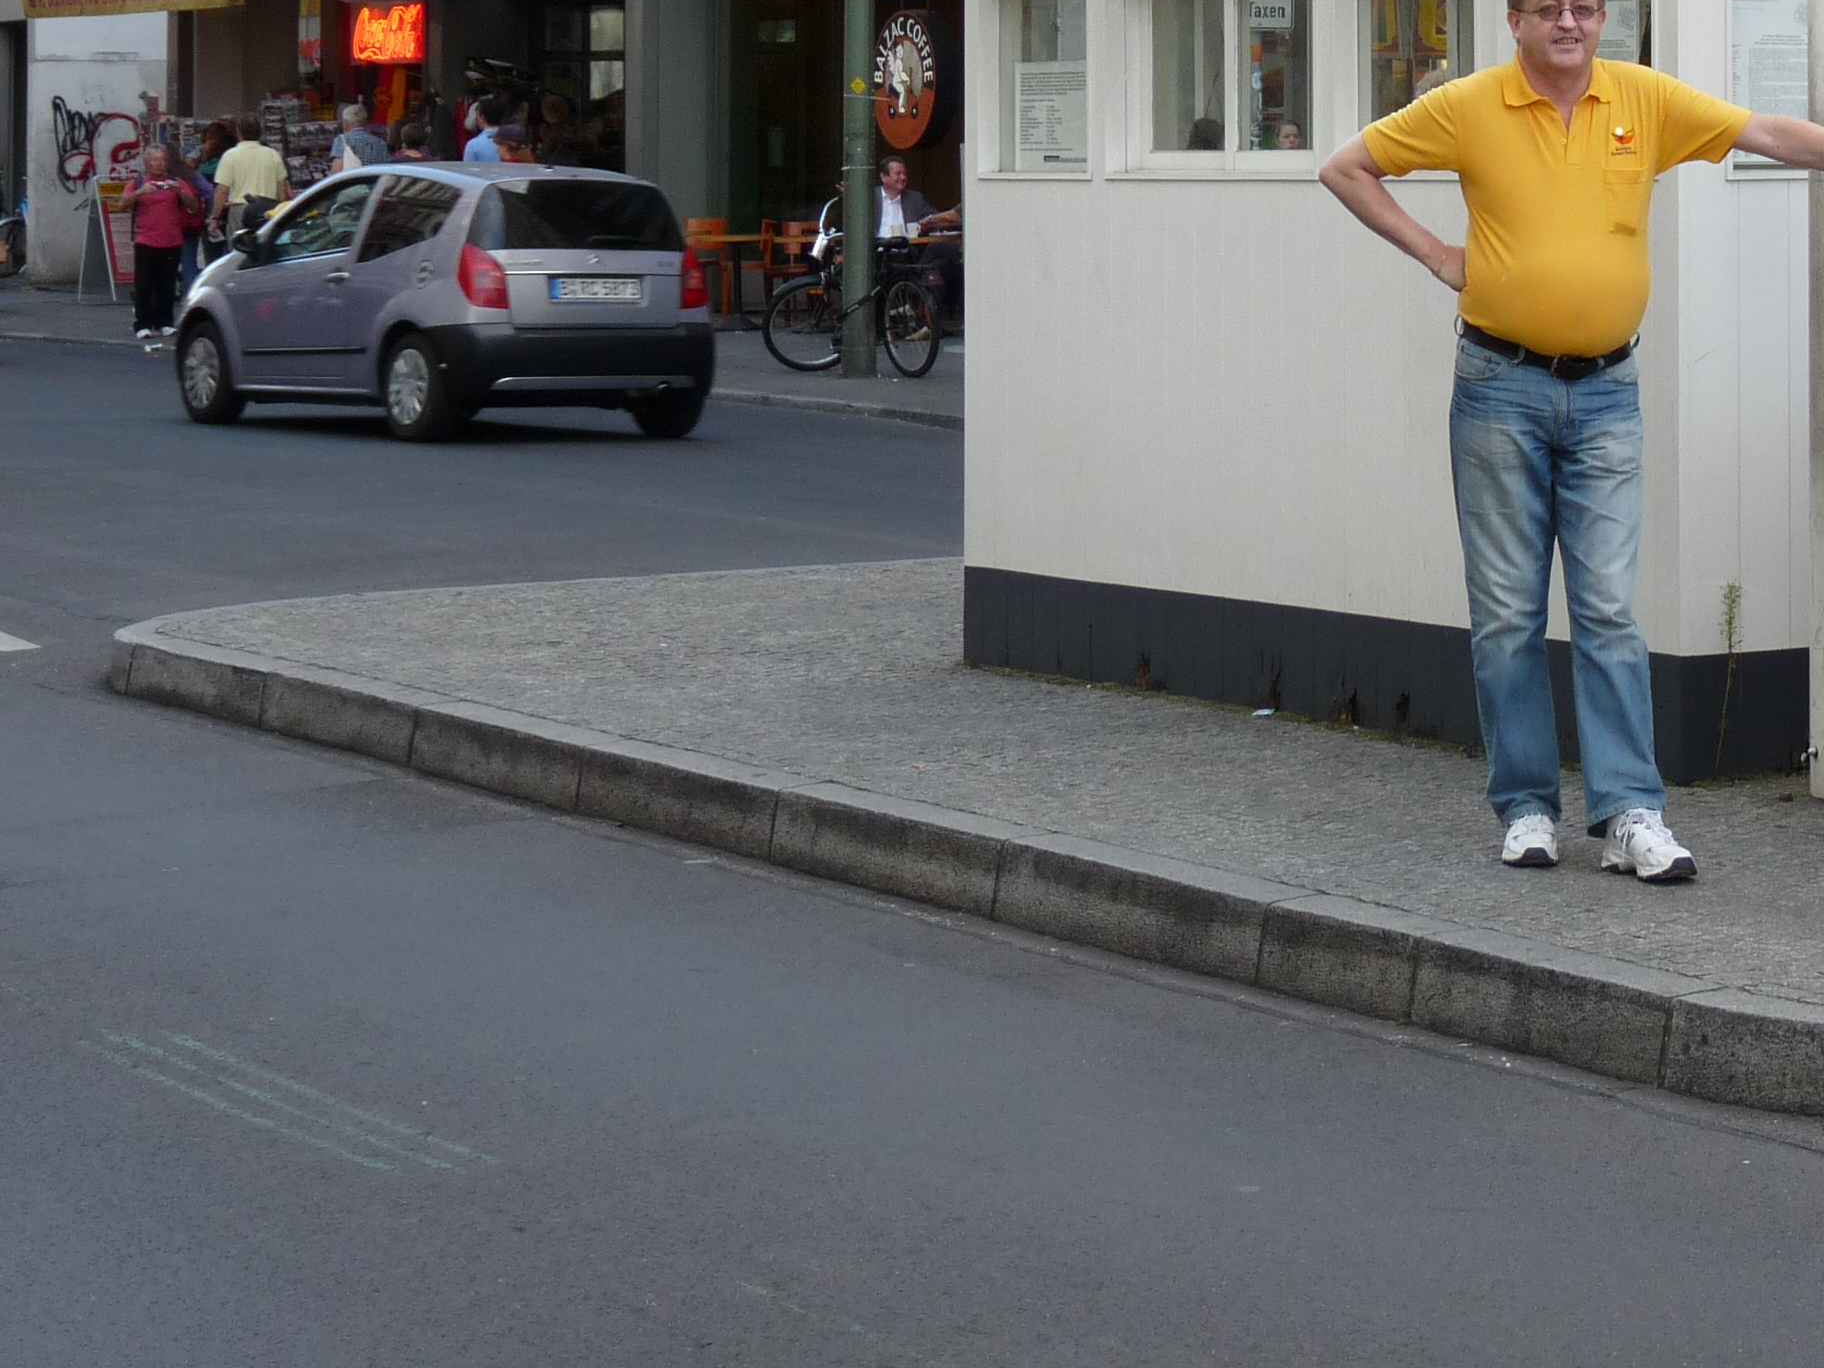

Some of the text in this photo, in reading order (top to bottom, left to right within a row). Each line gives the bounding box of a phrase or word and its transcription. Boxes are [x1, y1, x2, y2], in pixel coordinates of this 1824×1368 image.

[1249, 1, 1286, 19] Taxen
[874, 16, 934, 84] BALZAC COFFEE
